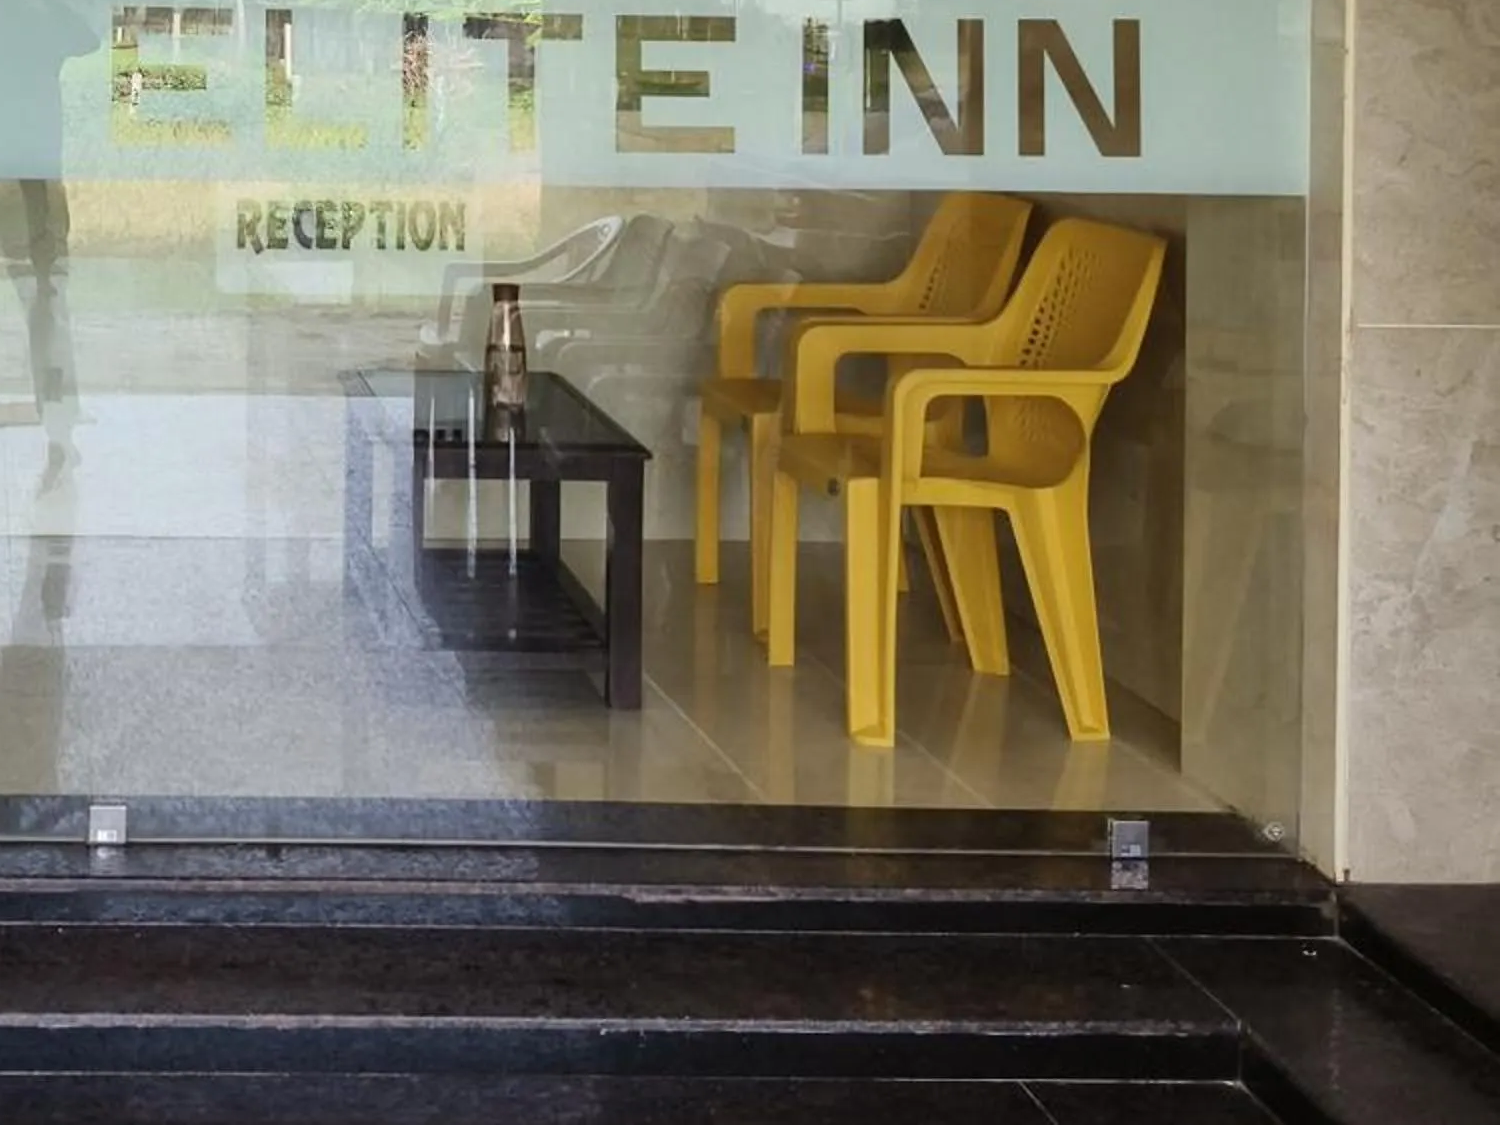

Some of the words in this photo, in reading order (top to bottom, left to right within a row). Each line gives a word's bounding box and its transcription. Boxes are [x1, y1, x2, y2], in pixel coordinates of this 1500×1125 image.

[110, 5, 737, 153] ELITE
[801, 18, 1141, 157] INN
[236, 199, 466, 254] RECEPTION
